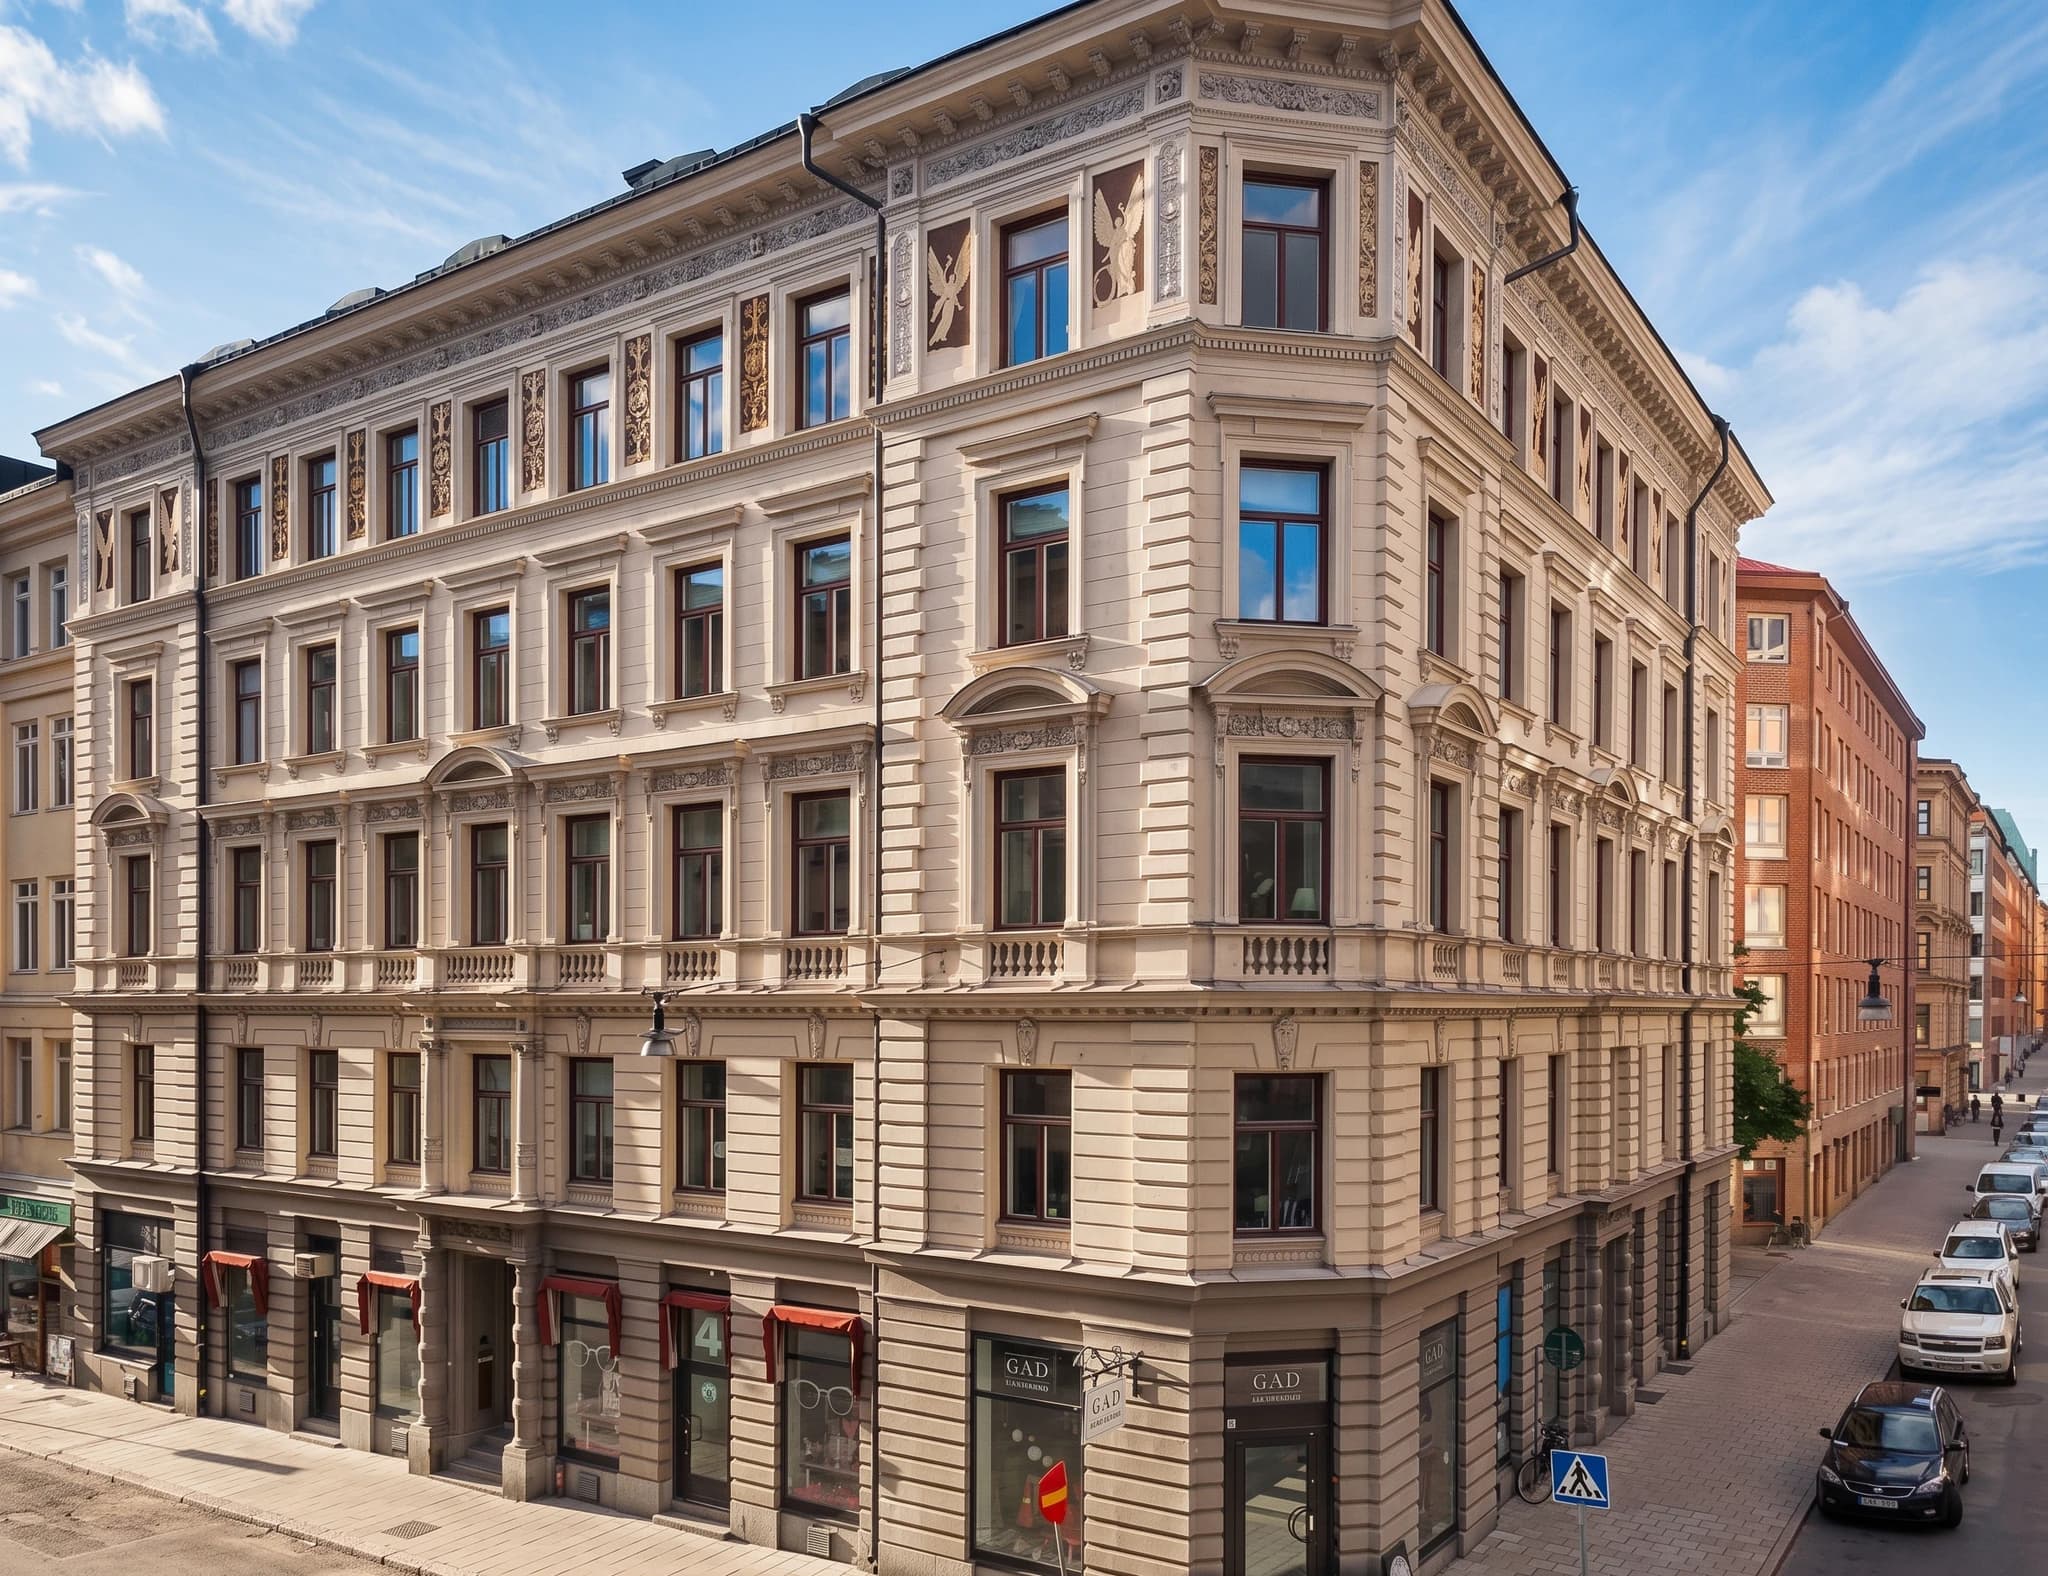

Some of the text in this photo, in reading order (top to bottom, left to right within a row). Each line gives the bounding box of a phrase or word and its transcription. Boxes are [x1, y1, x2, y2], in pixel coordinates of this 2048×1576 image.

[694, 1317, 722, 1357] 4
[1426, 1343, 1443, 1364] GAD
[1006, 1358, 1048, 1378] GAD
[1253, 1371, 1300, 1390] GAD
[1092, 1389, 1121, 1415] GAD
